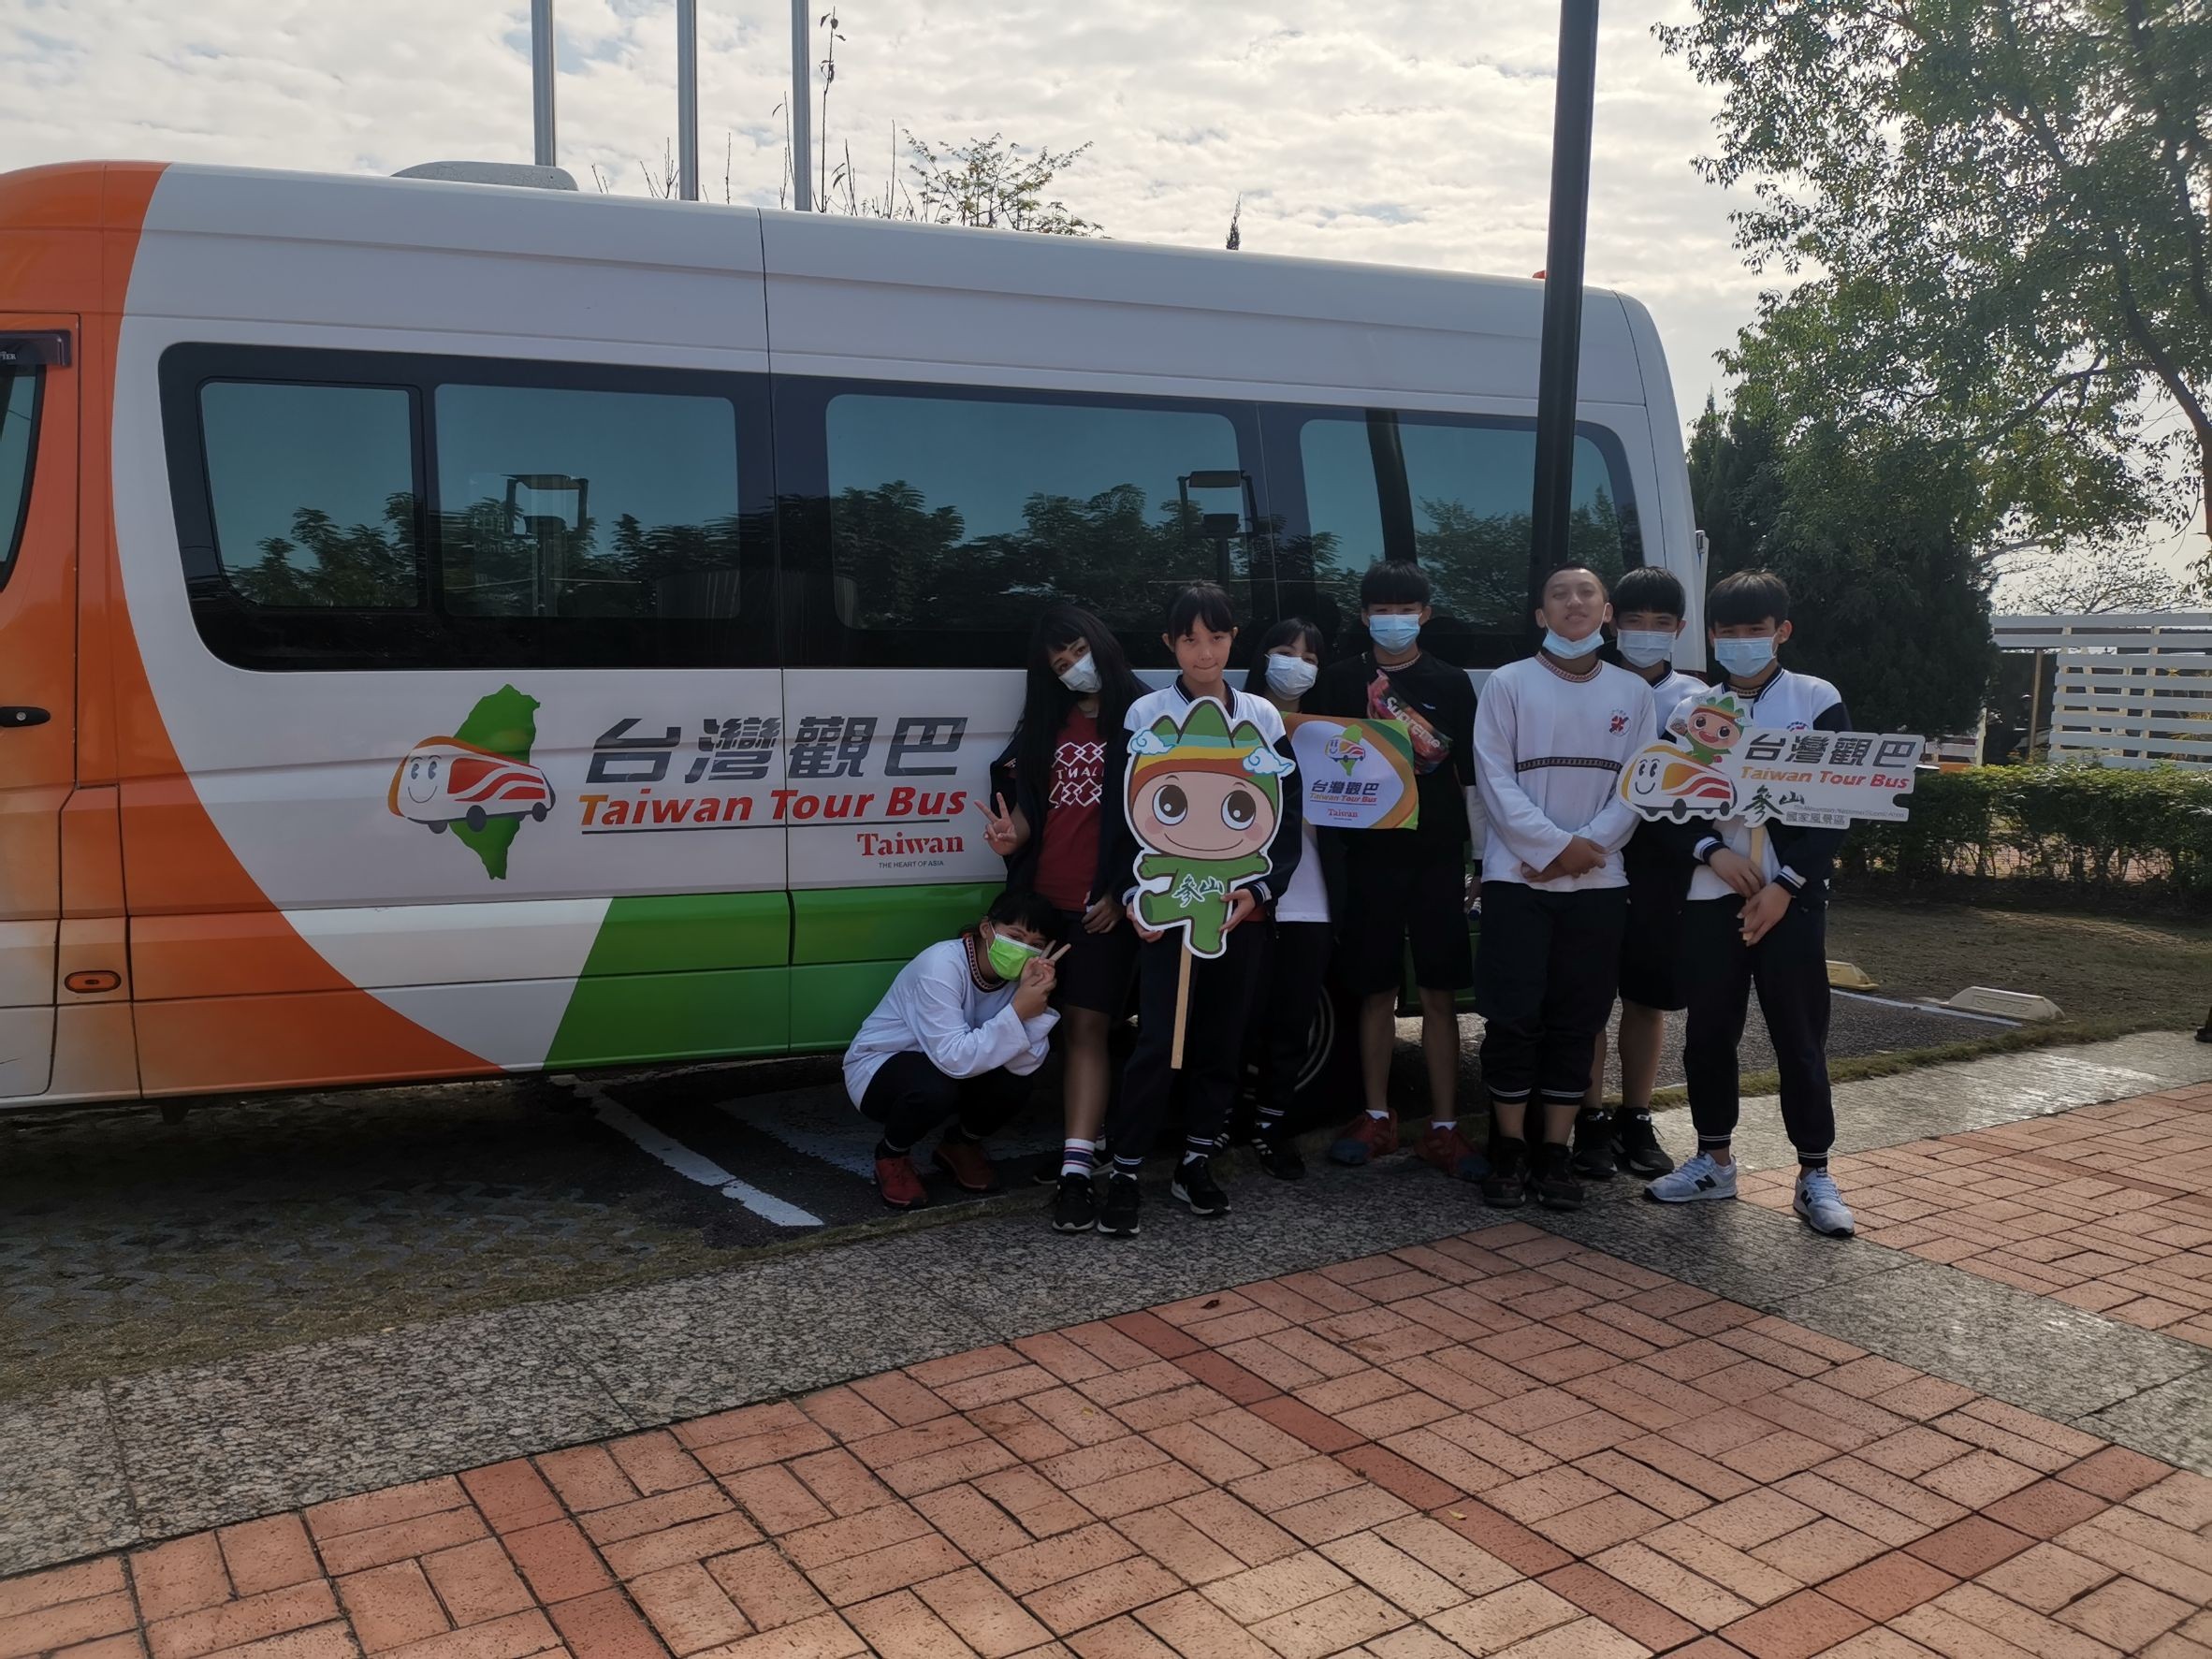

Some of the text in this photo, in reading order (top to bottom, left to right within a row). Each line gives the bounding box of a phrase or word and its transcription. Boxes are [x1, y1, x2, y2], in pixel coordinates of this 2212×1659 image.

[586, 717, 968, 784] 台灣觀巴
[1744, 734, 1916, 768] 台灣觀巴
[1311, 779, 1380, 795] 台灣觀巴
[1740, 765, 1910, 790] Taiwan Tour Bus
[578, 787, 968, 826] Taiwan Tour Bus
[1340, 794, 1361, 803] Tour
[1328, 808, 1359, 818] Taiwan
[856, 831, 965, 856] Taiwan
